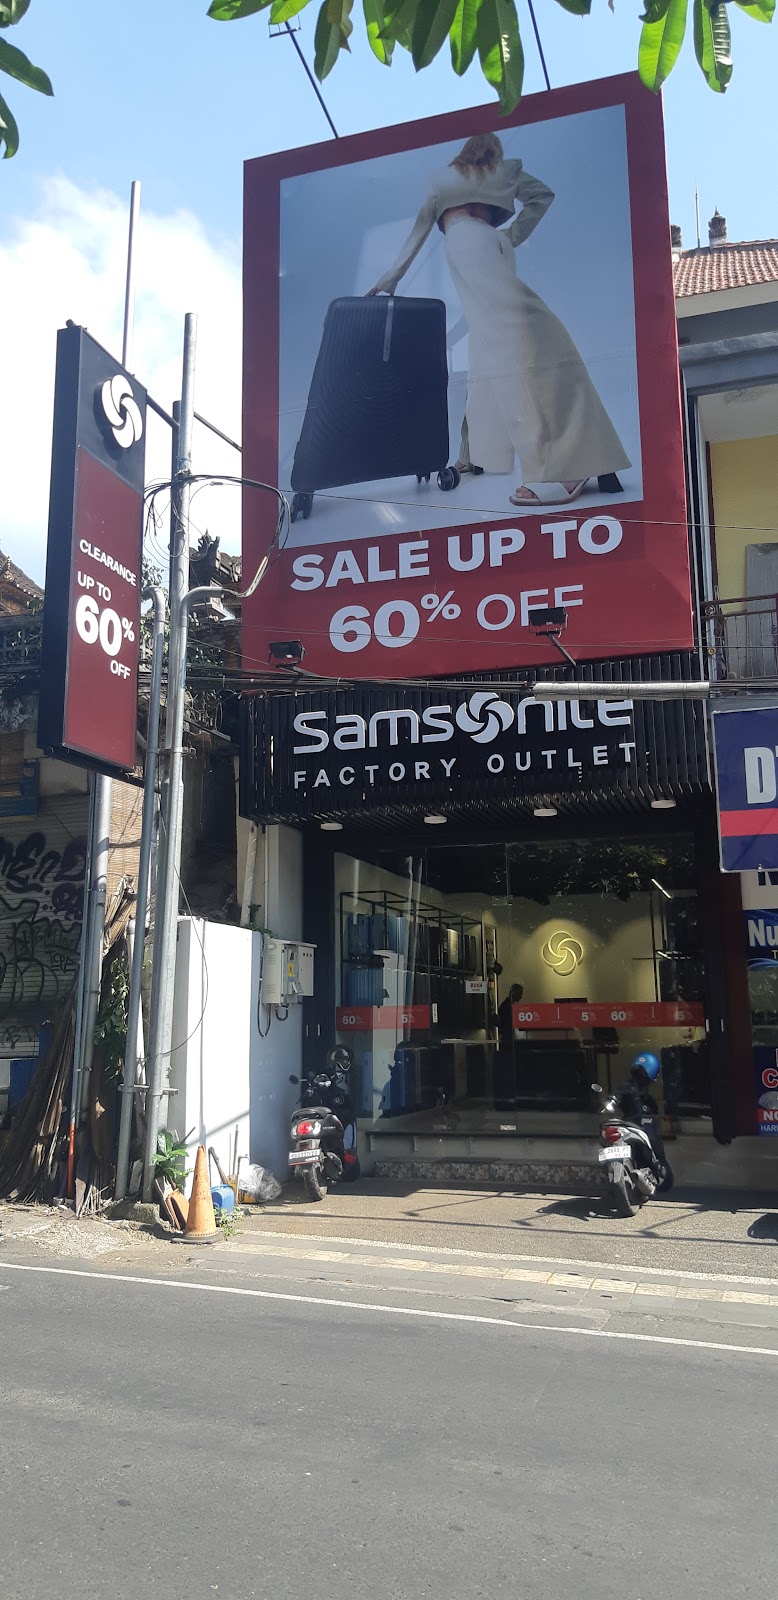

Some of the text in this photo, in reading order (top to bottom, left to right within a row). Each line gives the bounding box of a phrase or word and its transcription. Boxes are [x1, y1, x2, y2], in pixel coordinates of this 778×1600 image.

[79, 539, 137, 587] CLEARANCE
[290, 515, 623, 592] SALE UP TO
[77, 570, 112, 602] UP TO
[75, 594, 135, 657] 60%
[329, 584, 584, 653] 60% OFF
[110, 659, 131, 680] OFF
[294, 742, 637, 790] FACTORY OUTLET
[744, 745, 778, 805] D
[760, 1124, 778, 1132] HAR
